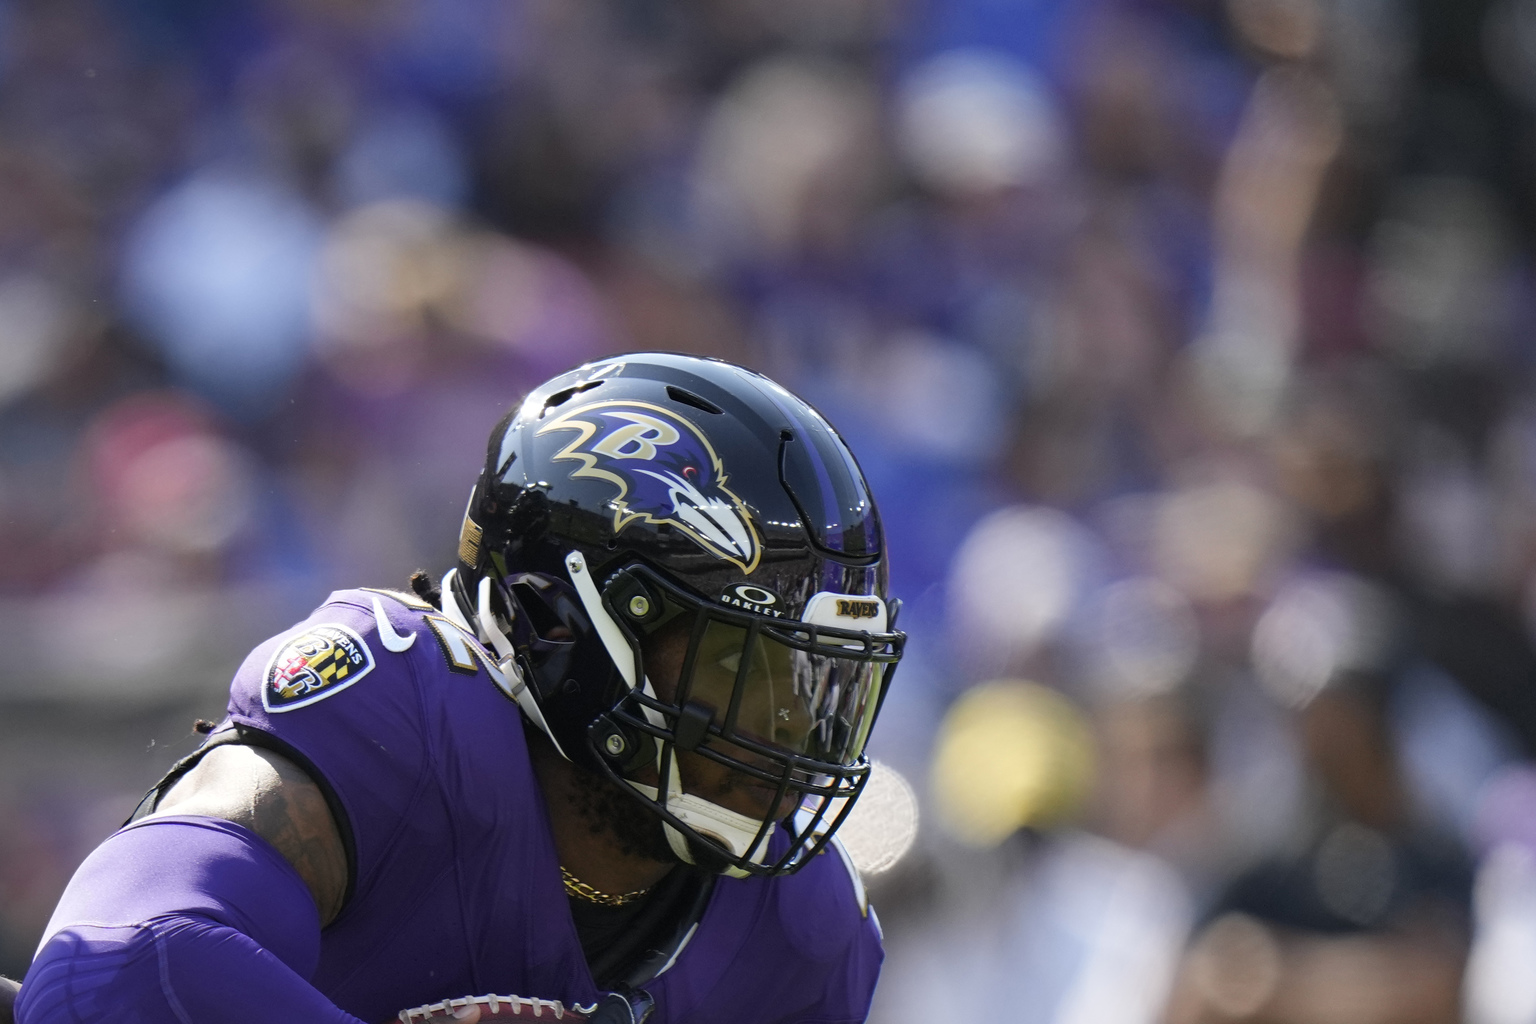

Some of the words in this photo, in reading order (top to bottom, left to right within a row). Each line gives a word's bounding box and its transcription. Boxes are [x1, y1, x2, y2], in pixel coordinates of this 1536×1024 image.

[591, 411, 681, 461] B
[721, 594, 782, 618] OAKLEY
[835, 599, 880, 619] RAVENS
